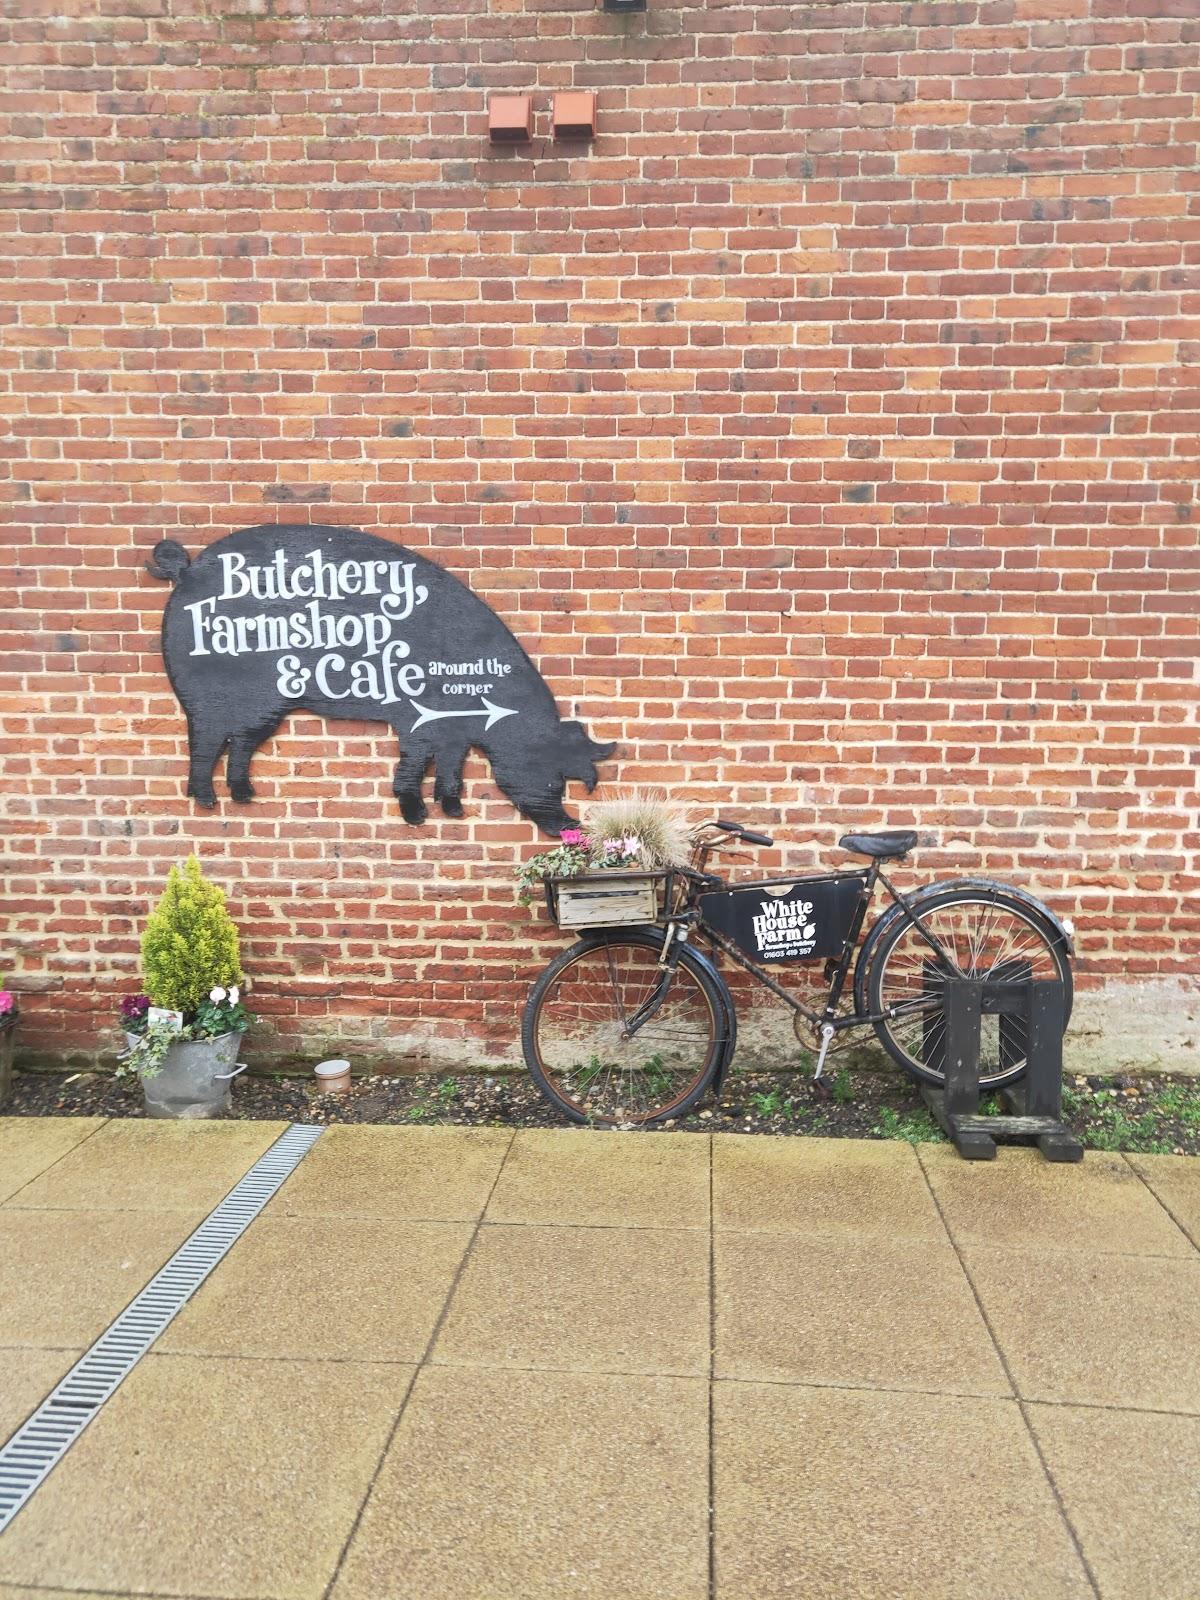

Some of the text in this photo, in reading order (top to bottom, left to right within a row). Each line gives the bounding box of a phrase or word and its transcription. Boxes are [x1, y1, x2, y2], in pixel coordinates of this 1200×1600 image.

[218, 549, 428, 620] Butchery,
[184, 599, 392, 656] Farmshop
[276, 640, 426, 705] & Cafe
[428, 657, 512, 677] around the
[442, 683, 493, 697] corner
[760, 899, 813, 919] White
[752, 915, 808, 935] House
[755, 928, 802, 951] Farm
